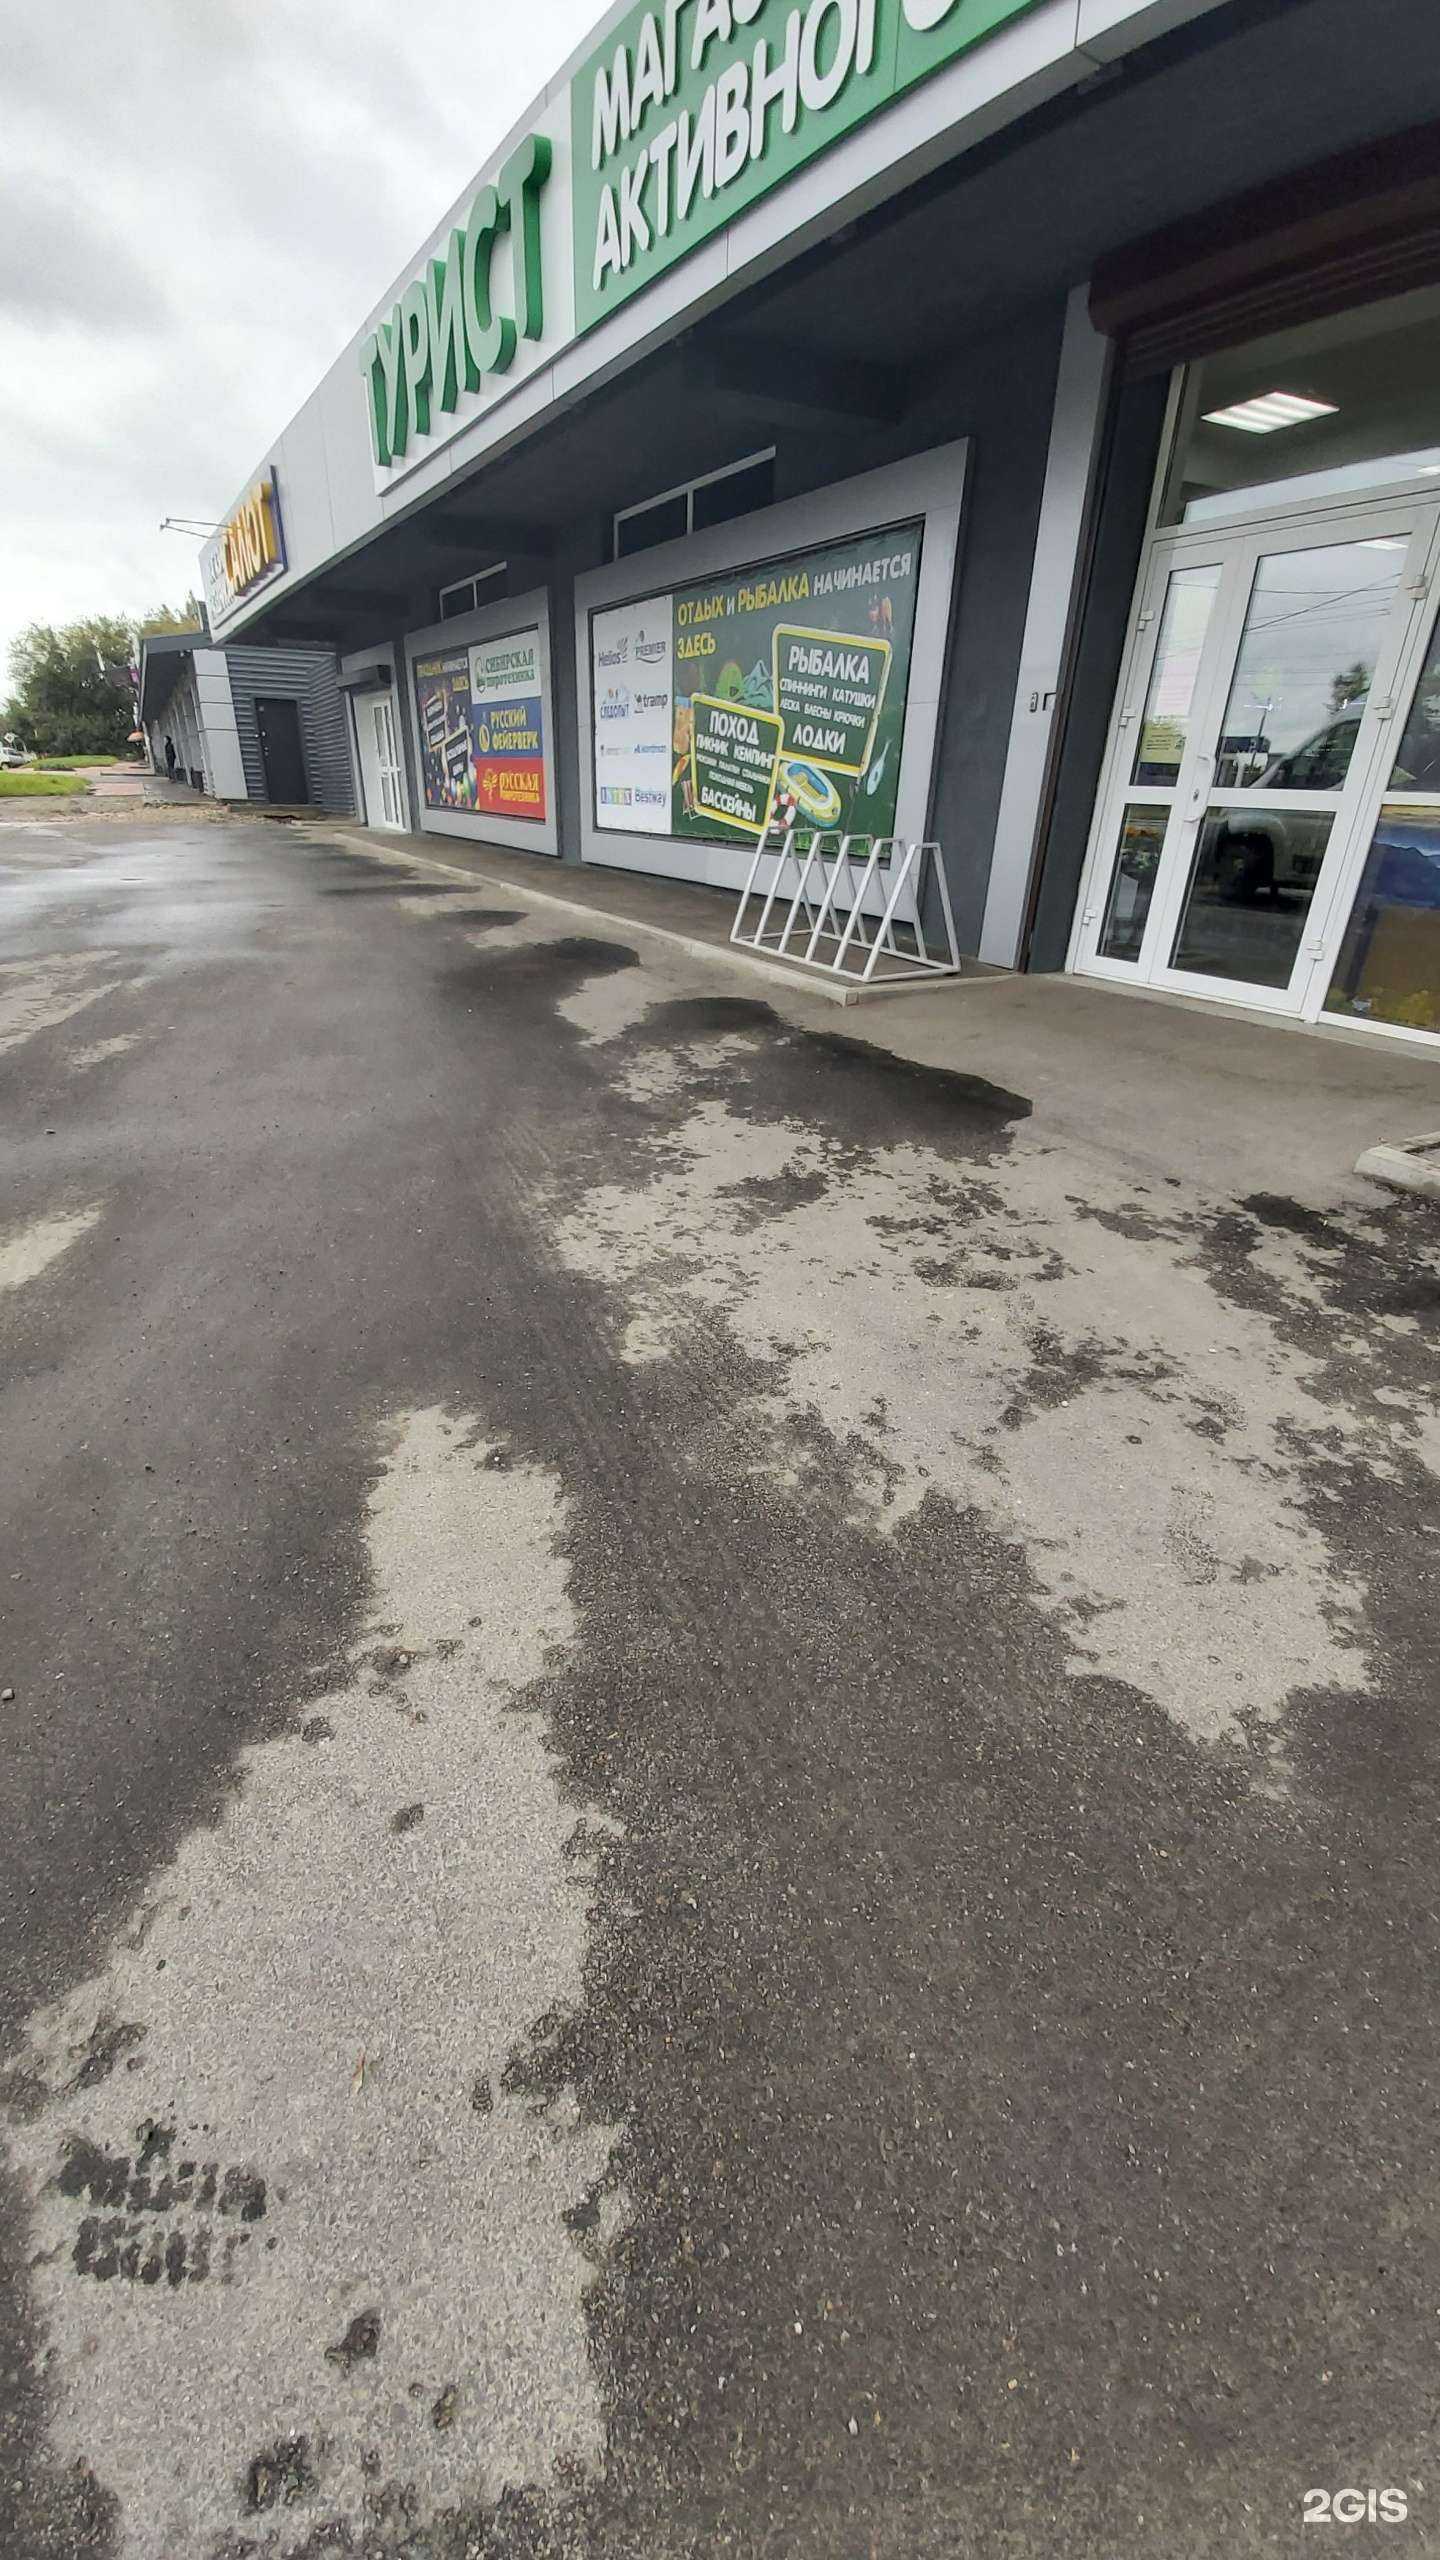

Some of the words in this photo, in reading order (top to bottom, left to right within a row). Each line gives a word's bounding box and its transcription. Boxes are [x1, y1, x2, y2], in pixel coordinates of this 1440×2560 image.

[359, 132, 552, 467] ТУРИСТ
[677, 594, 725, 626] ОТДЫХ
[737, 571, 810, 613] РЫБАЛКА
[813, 552, 912, 596] НАЧИНАЕТСЯ
[486, 648, 535, 674] СИБИРСКАЯ
[677, 631, 717, 660] ЗДЕСЬ
[788, 645, 870, 684] РЫБАЛКА
[832, 686, 877, 709] КАТУШКИ
[490, 706, 527, 729] РУССКИЙ
[709, 710, 760, 746] ПОХОД
[492, 730, 539, 751] ФЕЙЕРВЕРК
[696, 733, 729, 757] ПИКНИК
[733, 743, 776, 770] КЕМПИНГ
[792, 722, 847, 755] ЛОДКИ
[499, 772, 539, 793] РУССКАЯ
[701, 785, 757, 822] БАССЕЙНЫ
